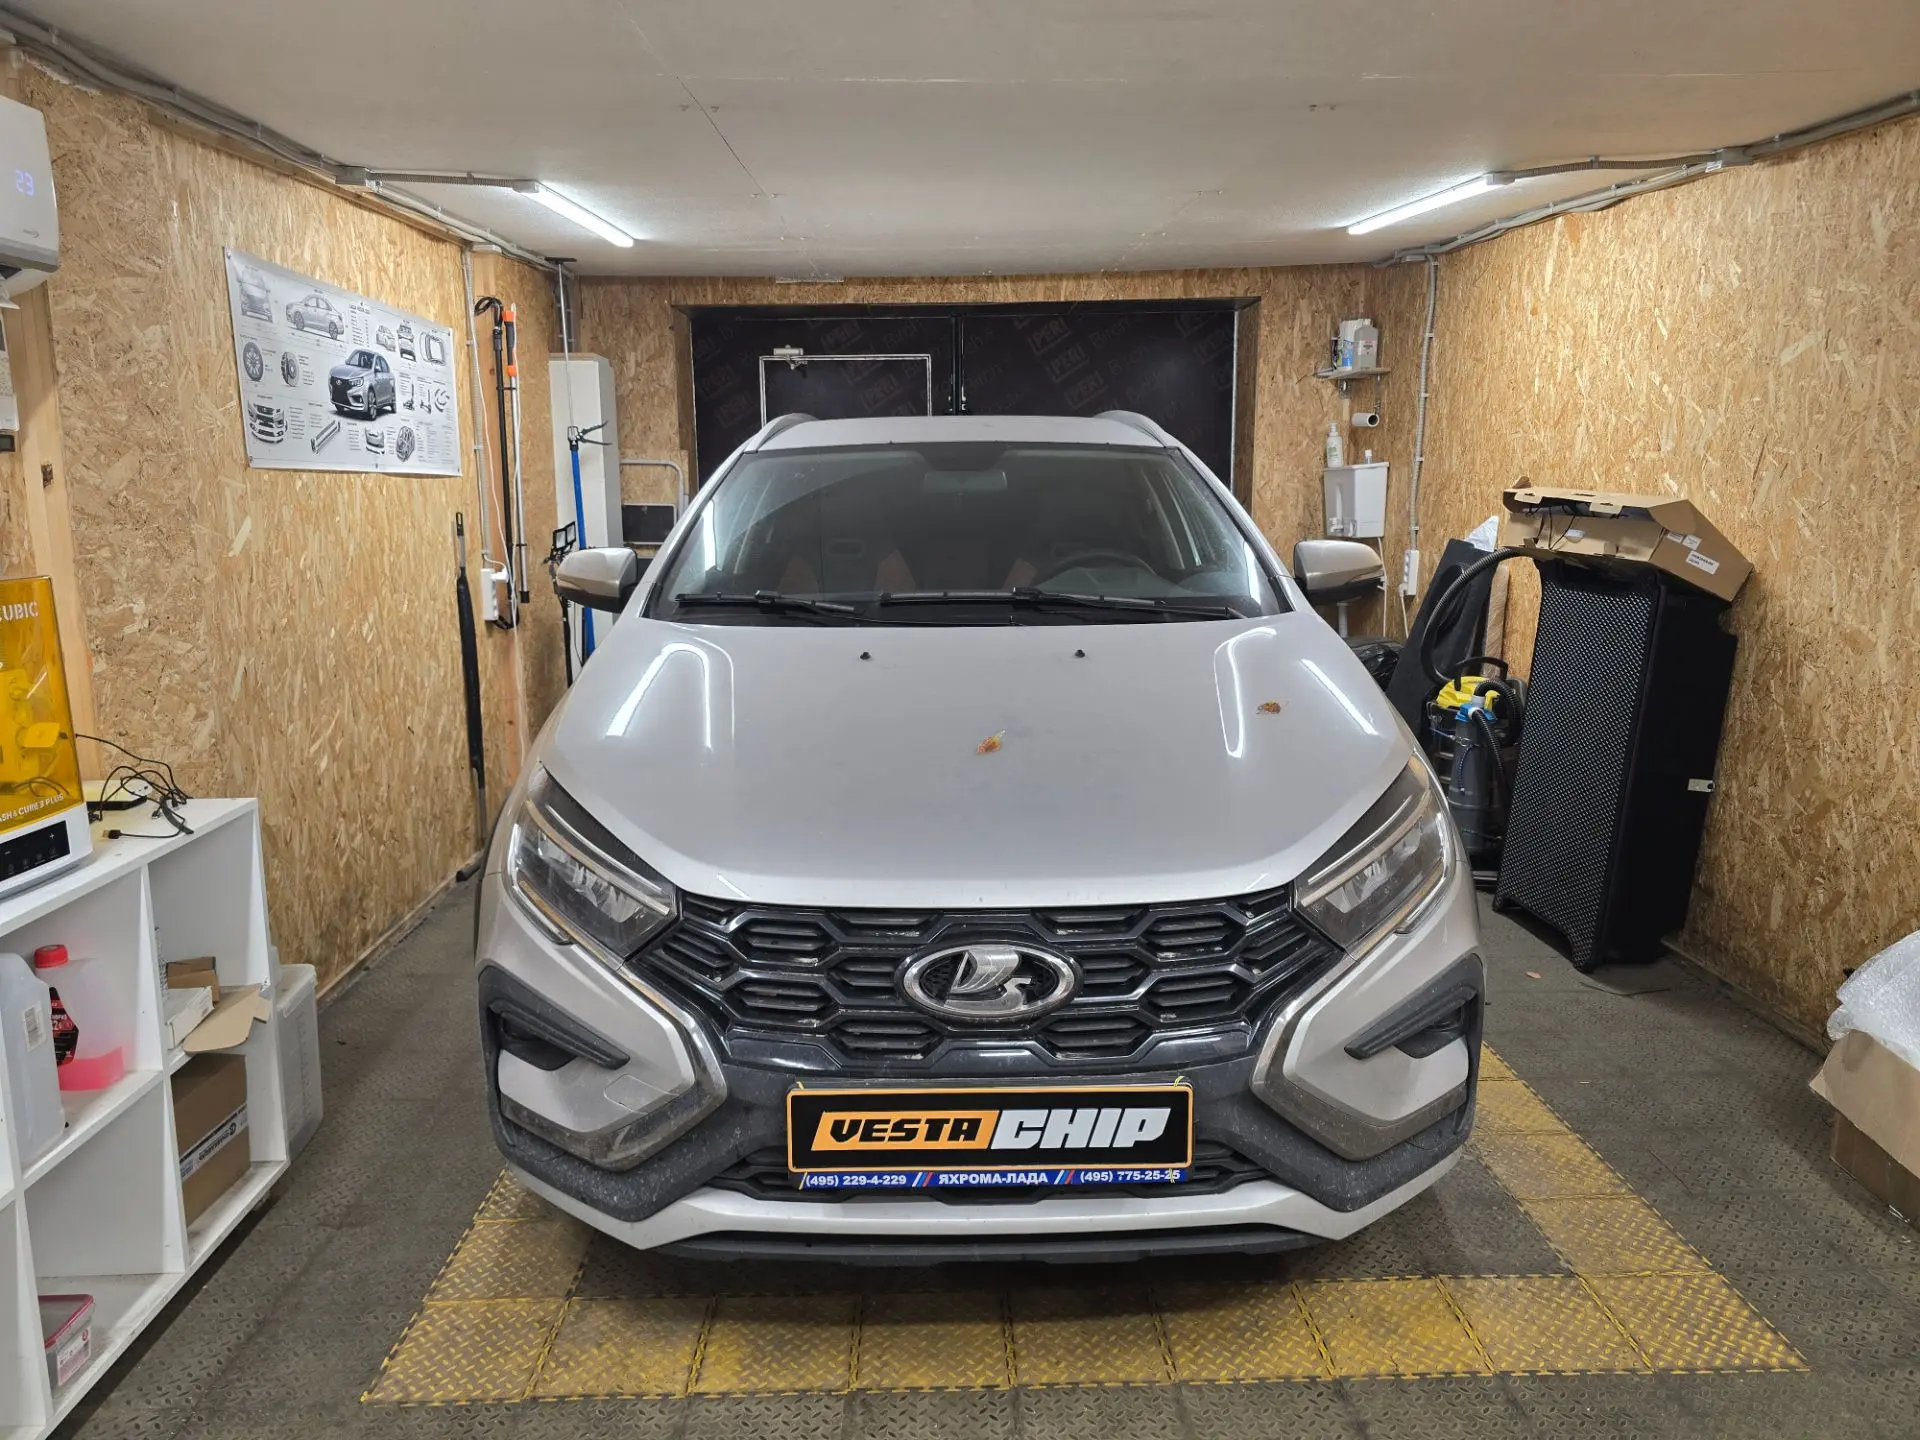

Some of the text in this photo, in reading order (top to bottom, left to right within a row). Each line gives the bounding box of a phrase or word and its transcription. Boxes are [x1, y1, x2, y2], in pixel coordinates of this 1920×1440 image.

[15, 167, 34, 196] 23
[1031, 316, 1070, 350] PERI
[1049, 341, 1087, 374] PERI
[1068, 369, 1106, 403] PERI
[45, 792, 65, 806] PLUS
[829, 1107, 1171, 1150] VESTA CHIP
[805, 1169, 1181, 1187] (495) 229-4-229 ЯХРОМА-ЛАДА (495) 775-25-25
